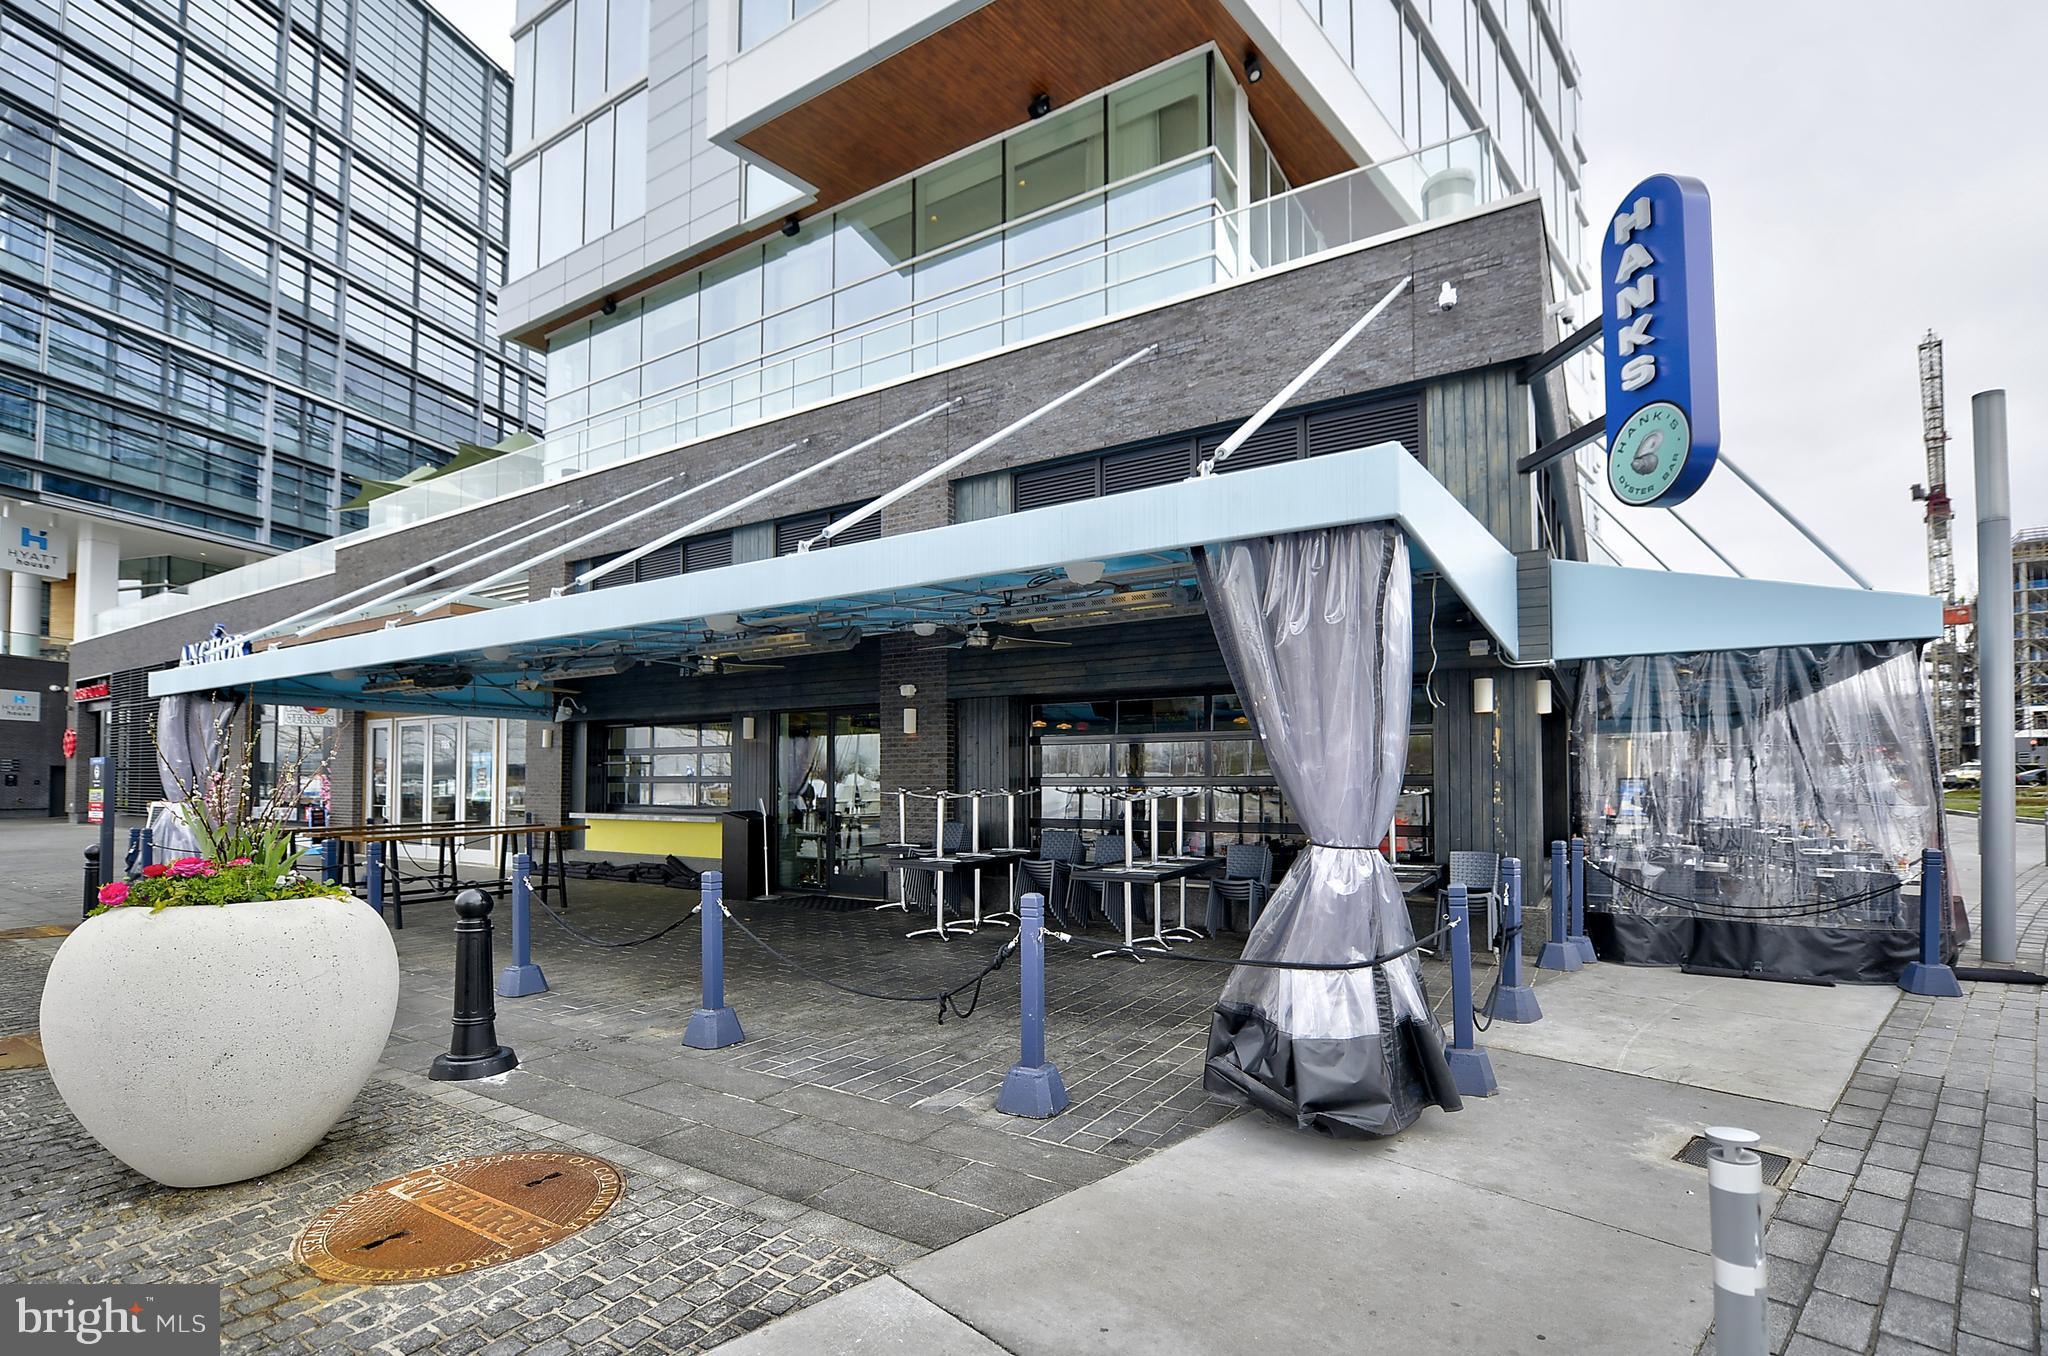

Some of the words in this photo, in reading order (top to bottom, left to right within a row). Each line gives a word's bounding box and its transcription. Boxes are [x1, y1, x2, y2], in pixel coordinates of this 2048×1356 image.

[1614, 196, 1656, 391] HANKS
[1618, 475, 1655, 495] OYSTER
[1662, 453, 1679, 481] BAR
[8, 549, 59, 564] HYATT
[16, 558, 50, 569] house
[2, 704, 37, 712] HYATT
[286, 714, 335, 725] JERRY'S
[430, 1152, 564, 1175] DISTRICT
[567, 1157, 598, 1167] OF
[402, 1175, 553, 1242] WHARF
[562, 1167, 618, 1230] COLUMBIA
[313, 1250, 512, 1280] WATERFRONT
